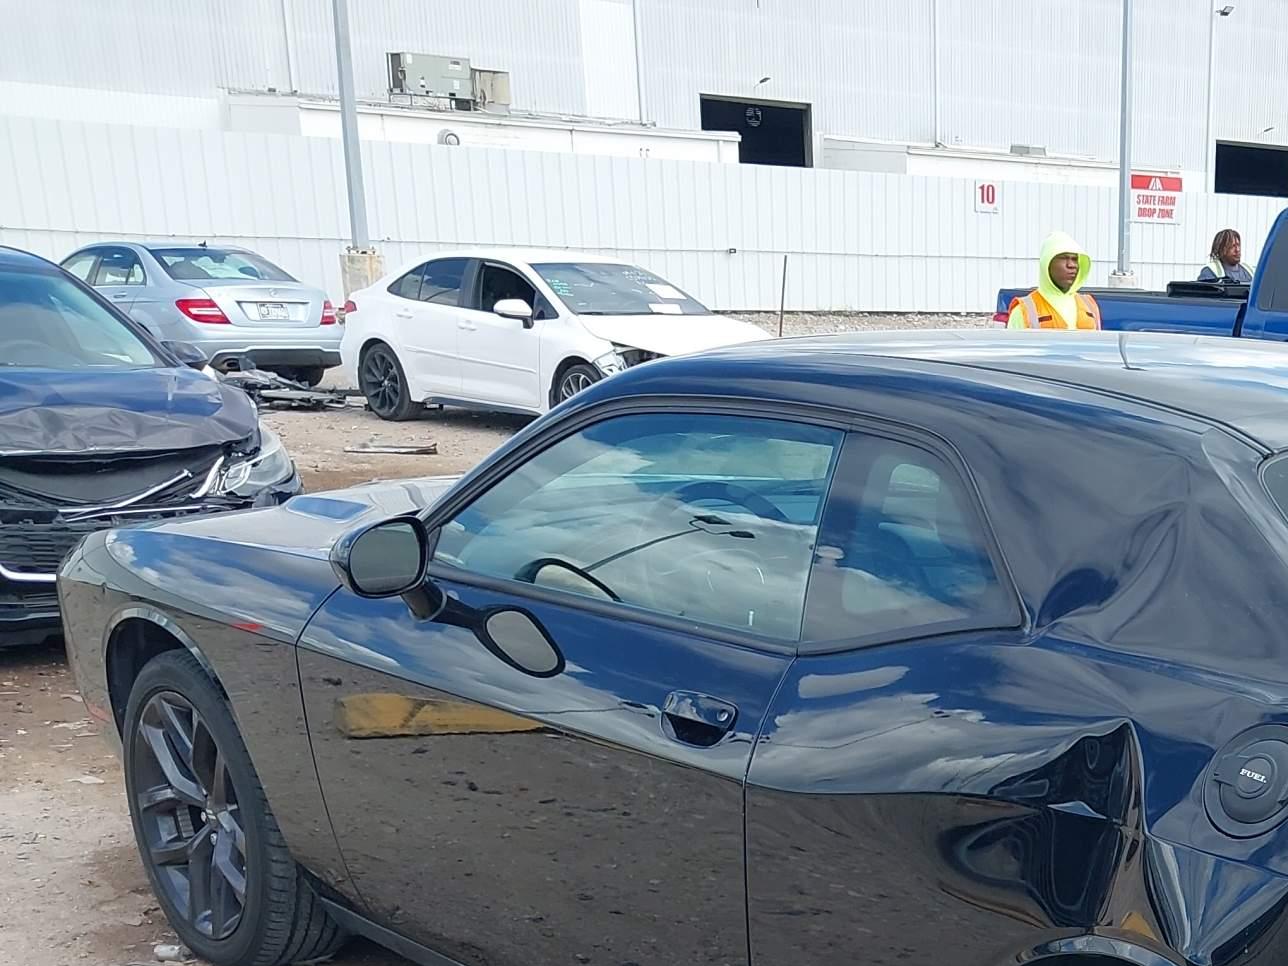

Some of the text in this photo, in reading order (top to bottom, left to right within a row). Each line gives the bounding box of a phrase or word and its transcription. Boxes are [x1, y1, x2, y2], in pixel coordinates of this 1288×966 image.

[978, 184, 995, 204] 10
[1136, 194, 1176, 206] STATE FARM
[1137, 207, 1174, 219] DROP ZONE
[1240, 768, 1267, 783] FUEL
